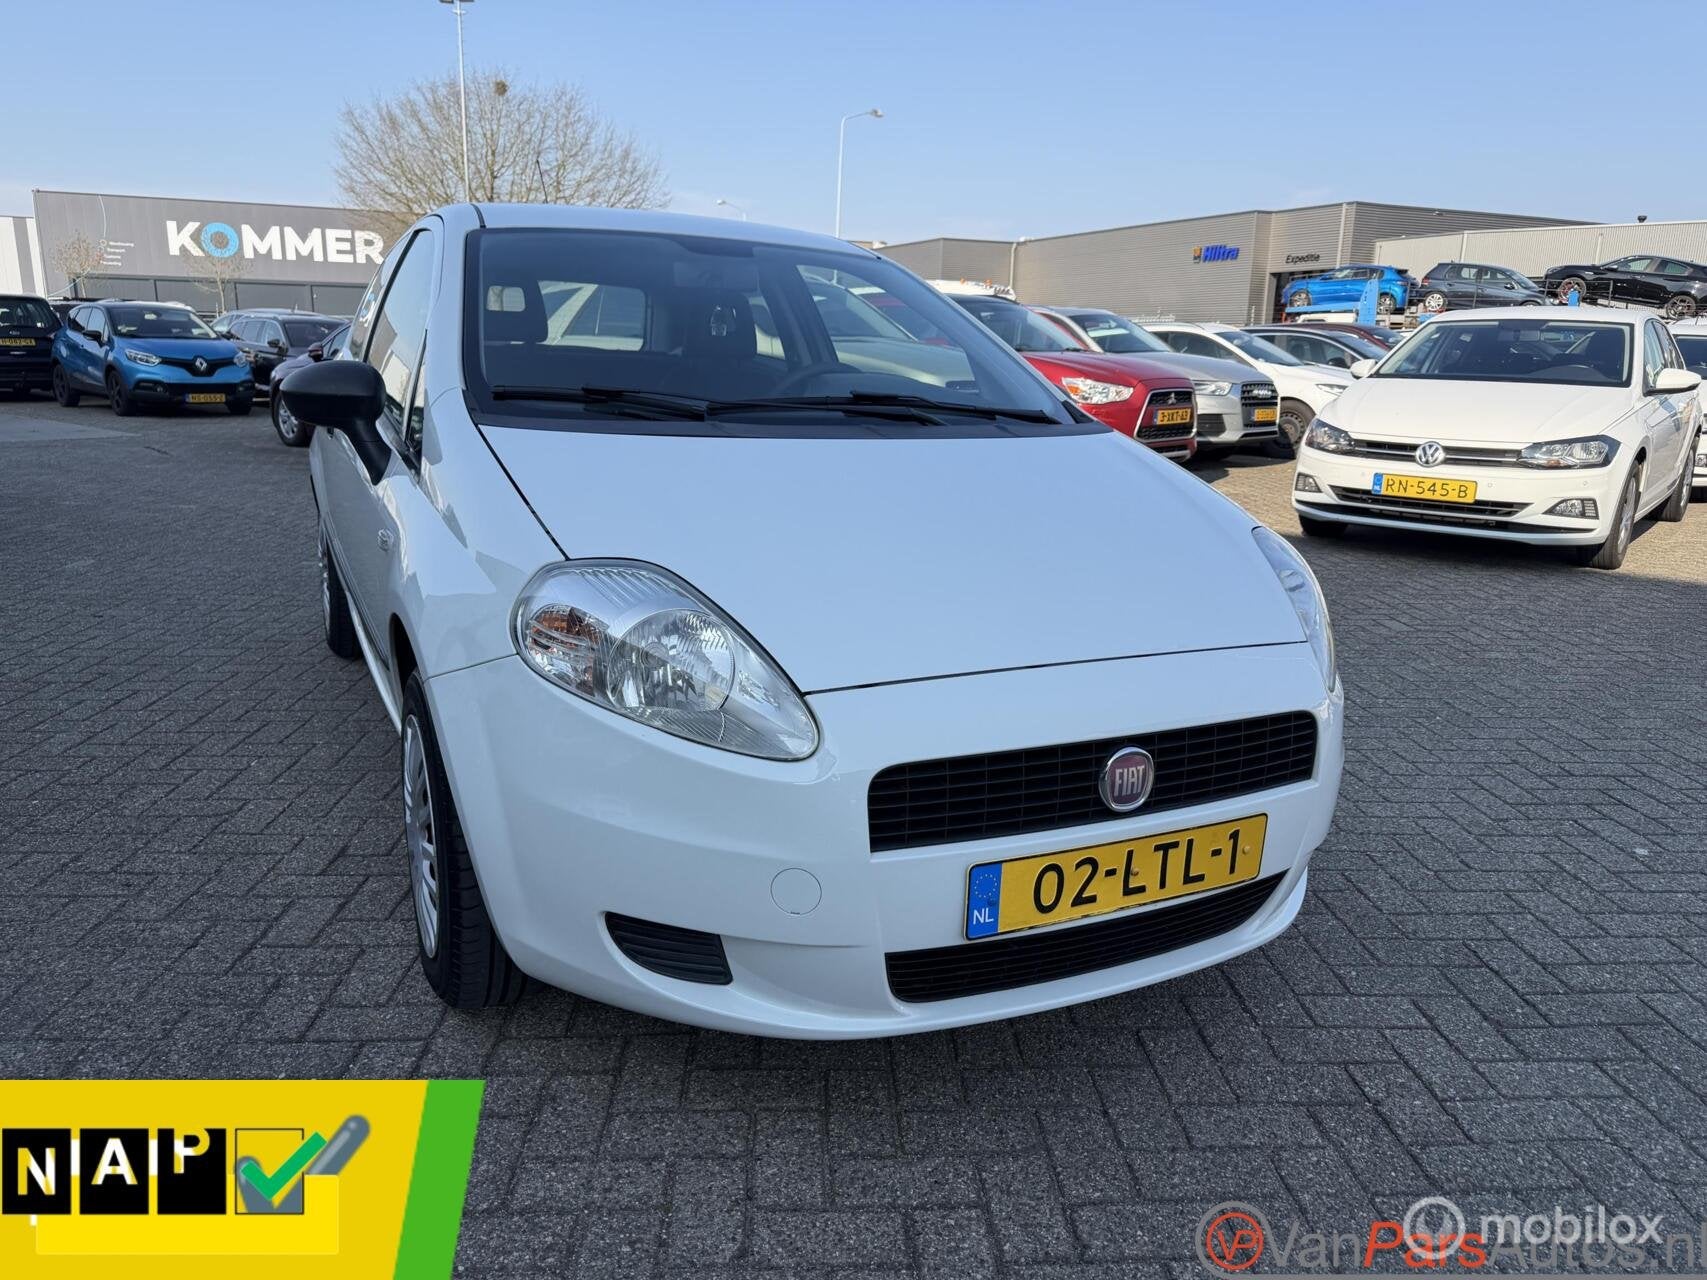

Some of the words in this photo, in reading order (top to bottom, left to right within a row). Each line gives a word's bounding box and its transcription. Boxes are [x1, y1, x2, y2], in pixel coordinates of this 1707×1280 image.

[166, 220, 384, 264] KOMMER
[1385, 478, 1469, 499] RN-545-B
[1113, 765, 1146, 797] FIAT
[1033, 829, 1241, 914] 02-LTL-1
[973, 908, 995, 926] NL
